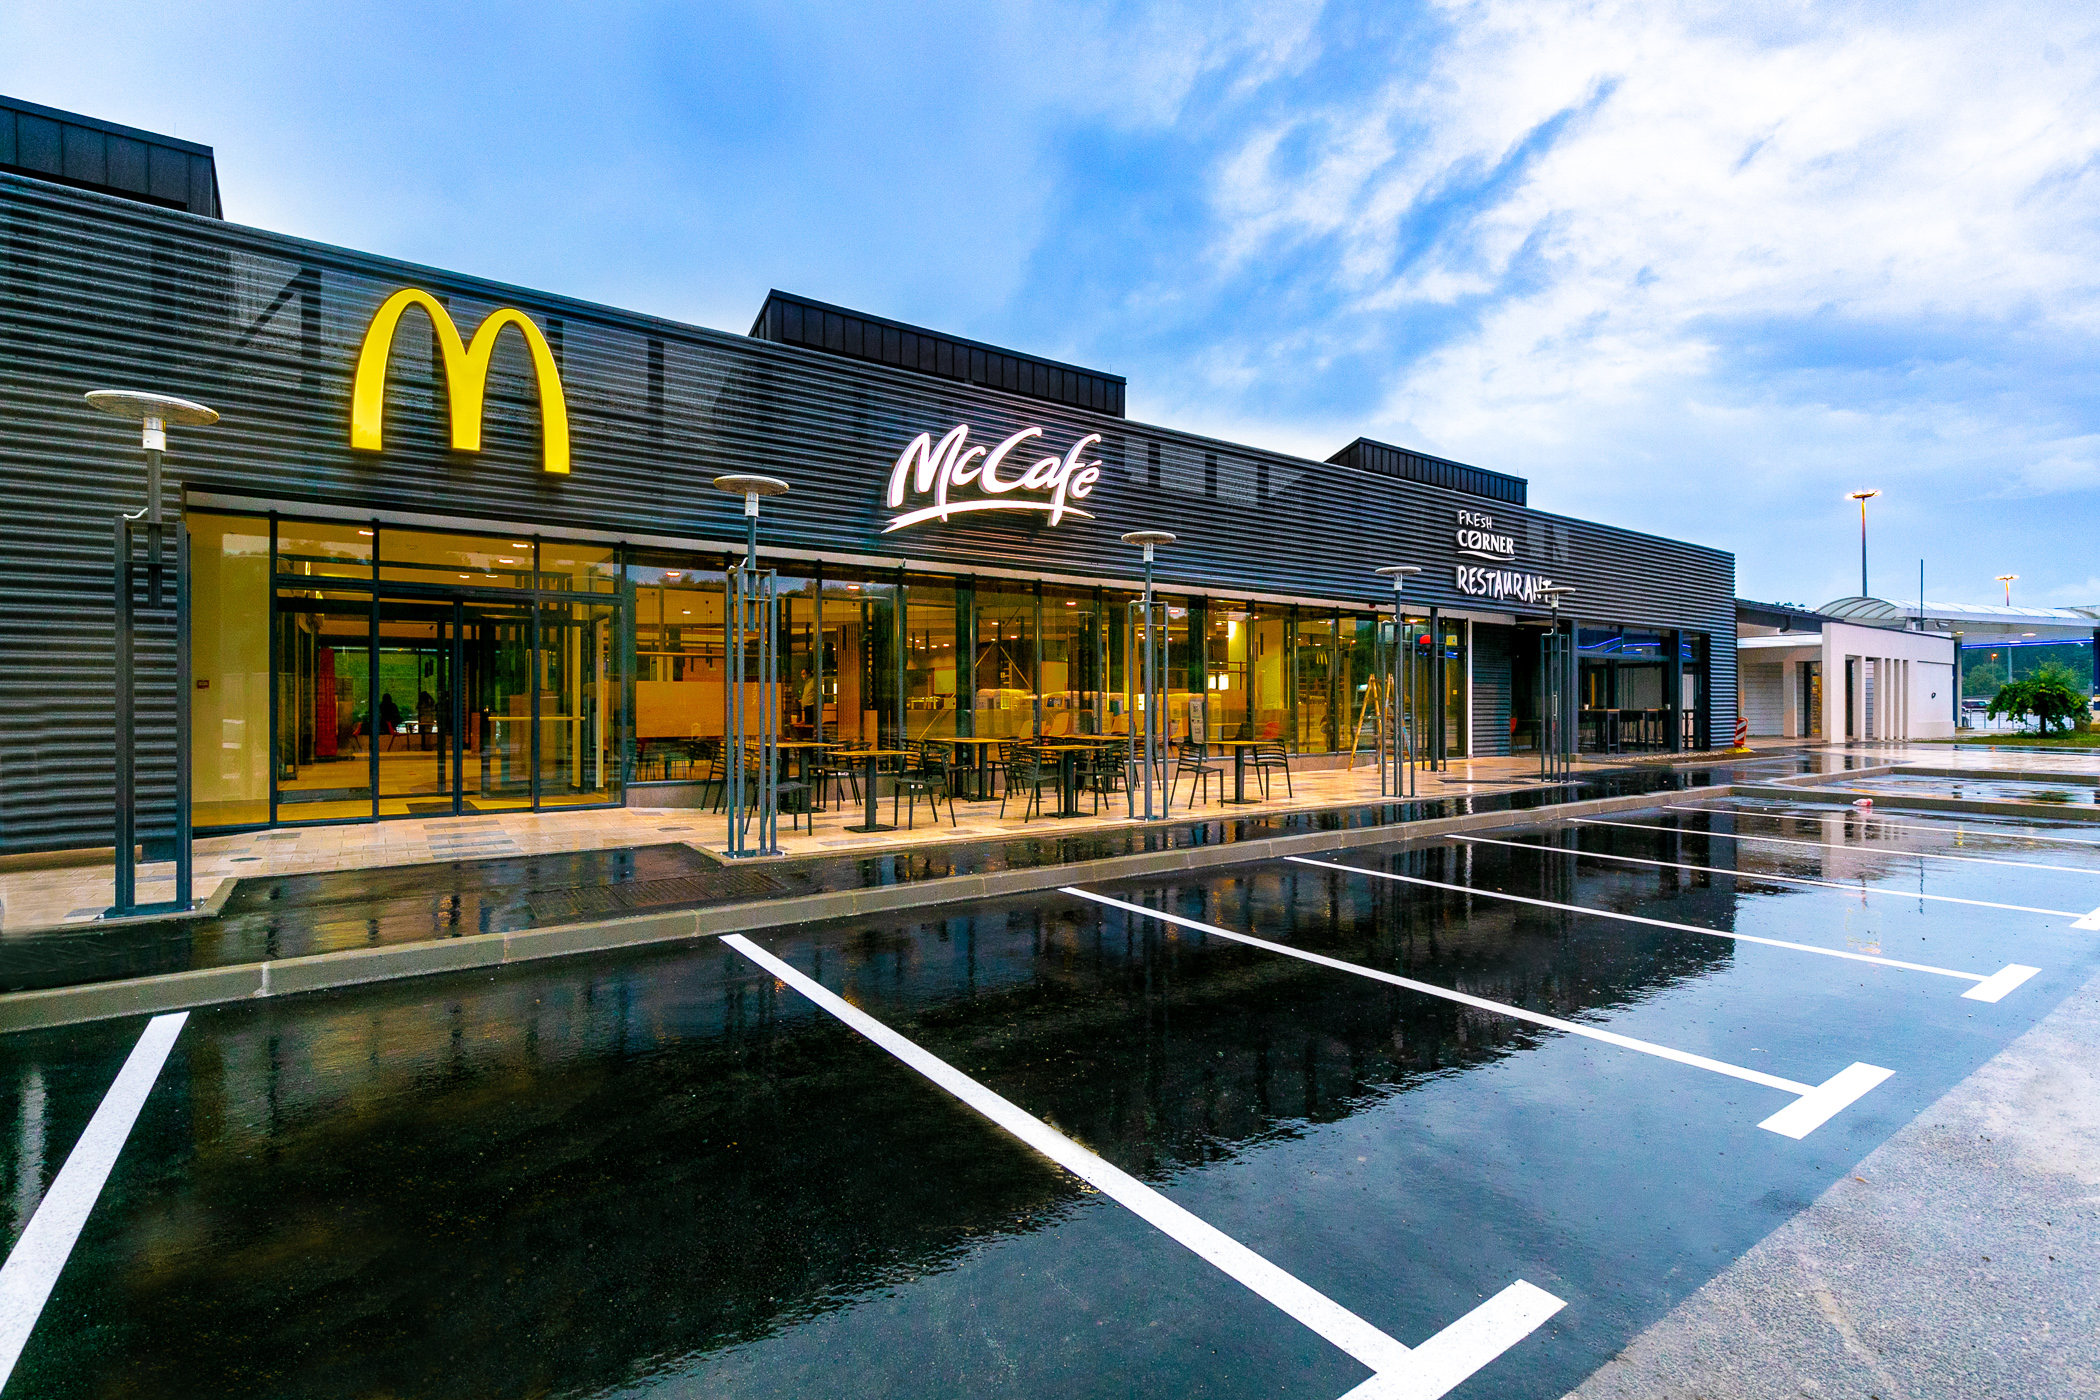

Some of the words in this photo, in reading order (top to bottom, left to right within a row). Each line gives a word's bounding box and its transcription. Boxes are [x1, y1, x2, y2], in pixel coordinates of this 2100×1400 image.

[351, 287, 570, 474] M
[887, 424, 1102, 526] McCafé
[1457, 510, 1492, 529] FRESH
[1457, 530, 1514, 554] CORNER
[1457, 565, 1551, 603] RESTAURANT
